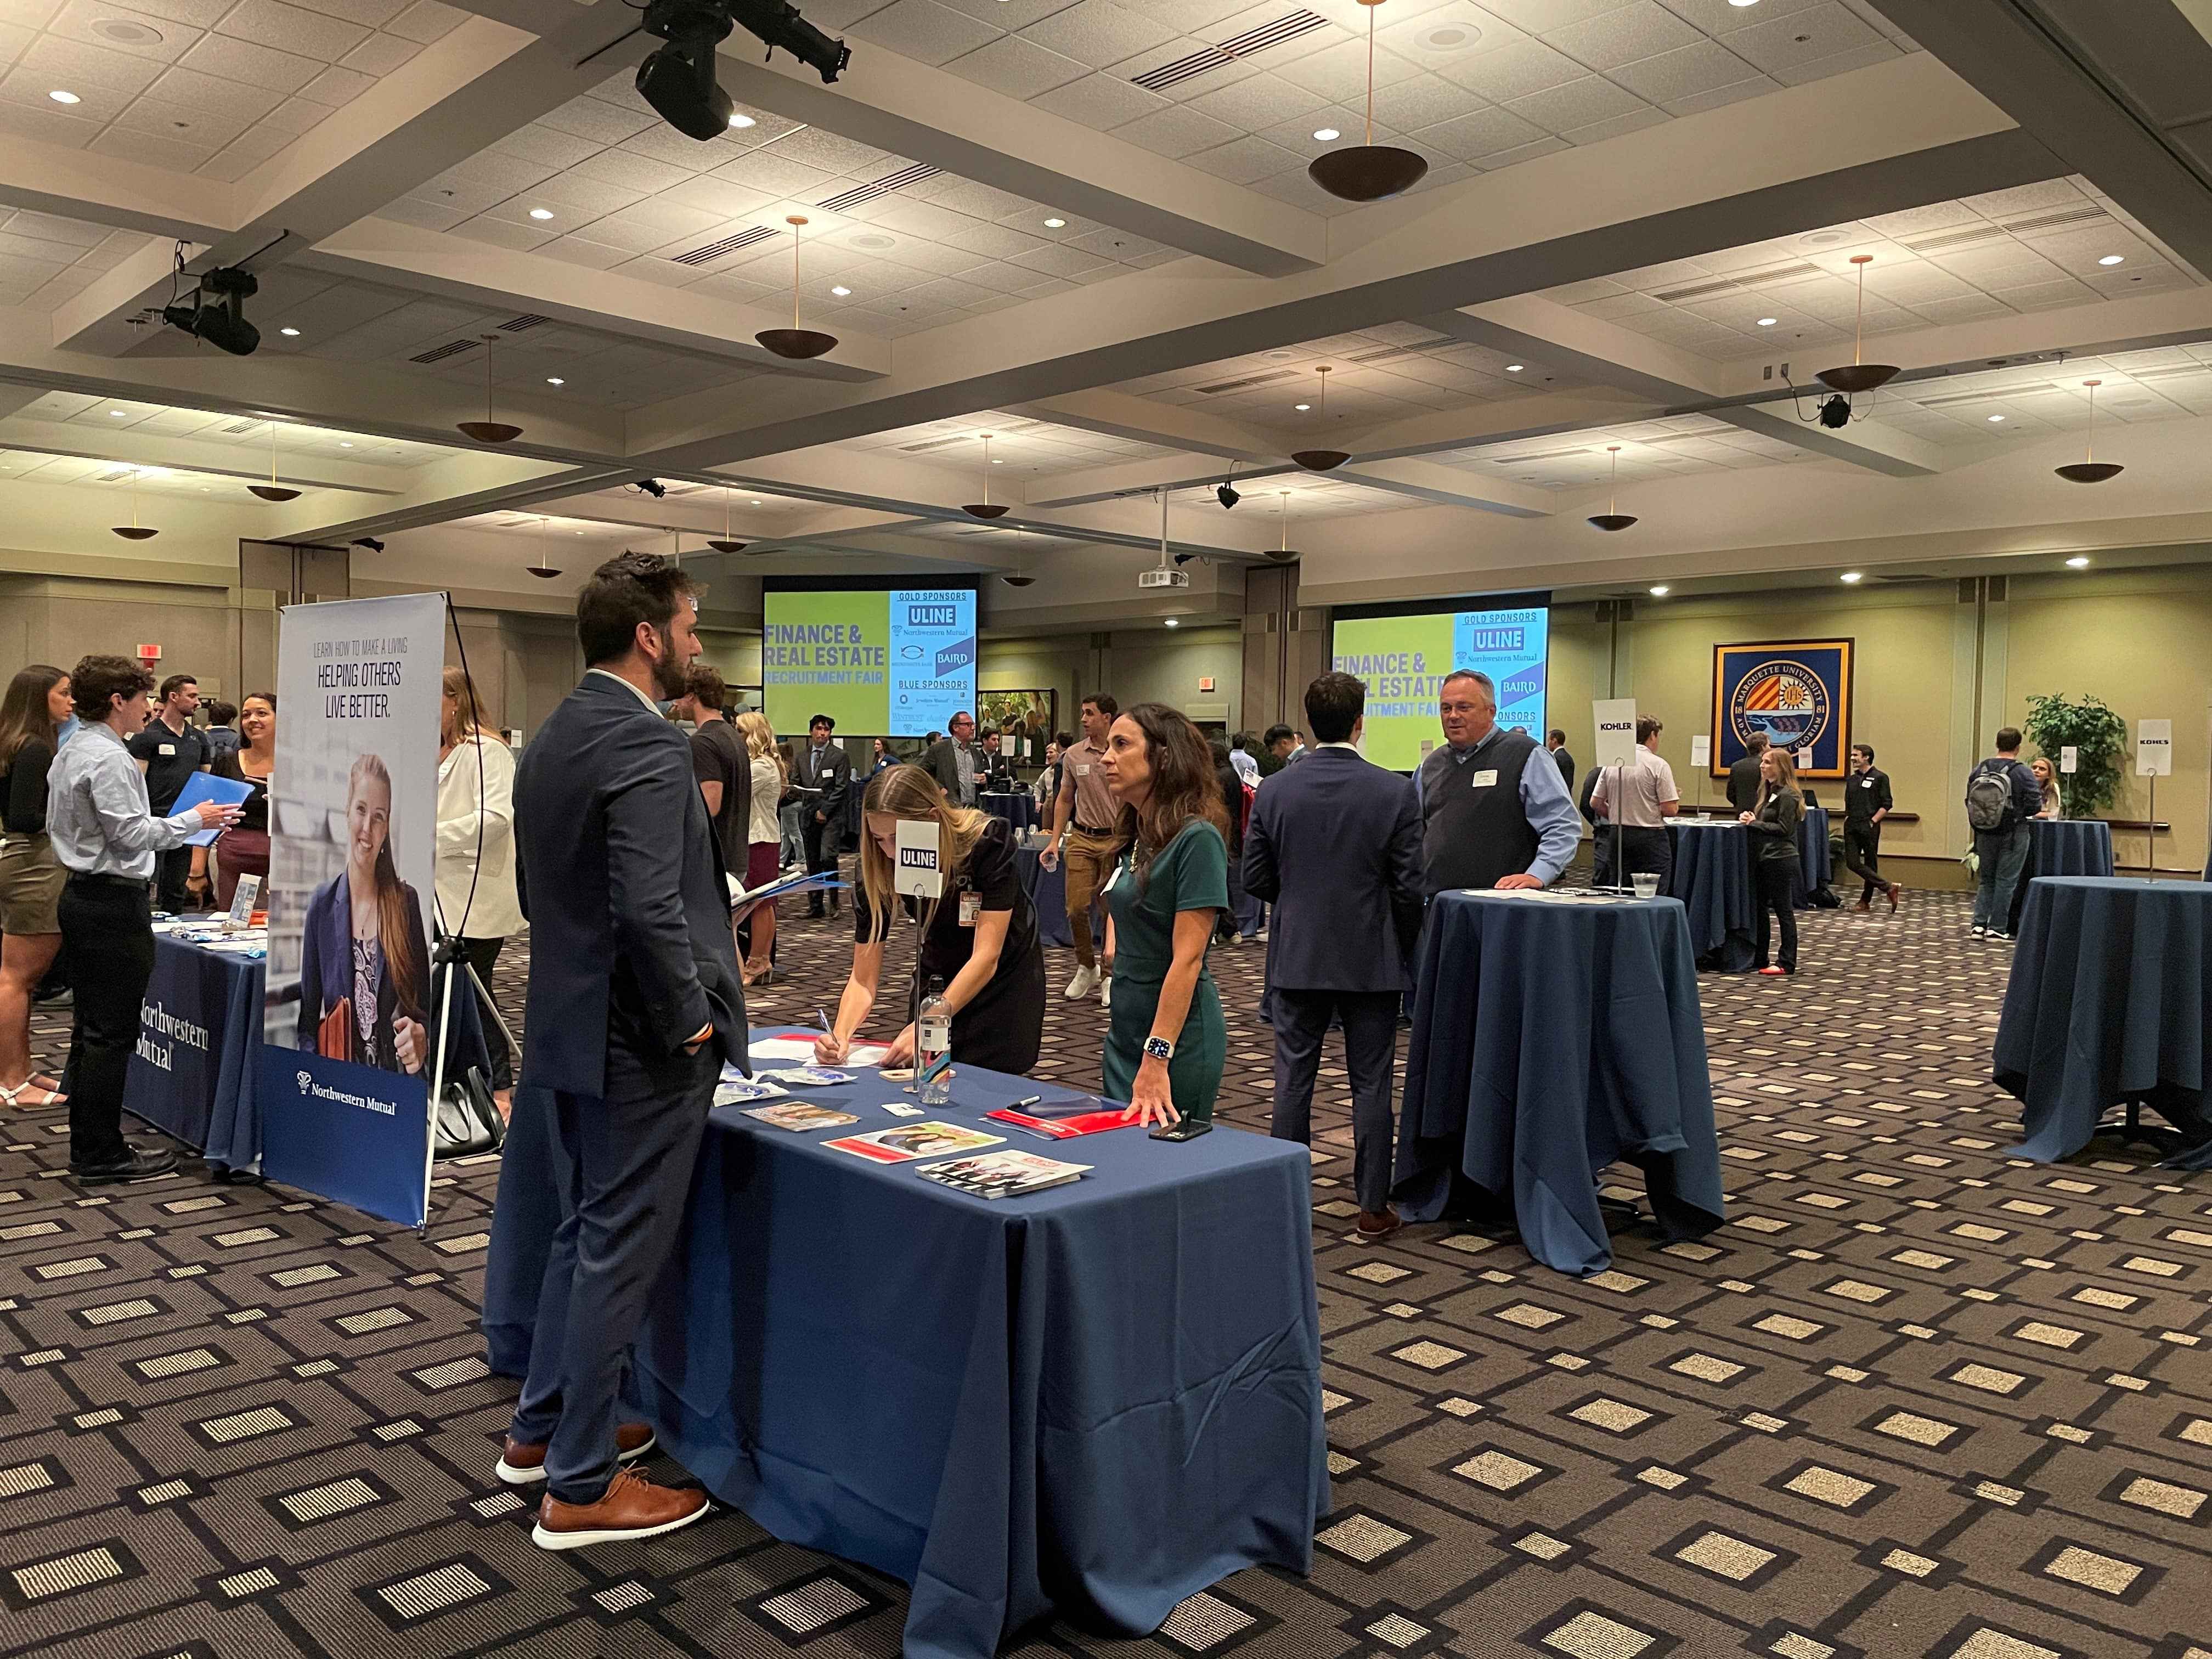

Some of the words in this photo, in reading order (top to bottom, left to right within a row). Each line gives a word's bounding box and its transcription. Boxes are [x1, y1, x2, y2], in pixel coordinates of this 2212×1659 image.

[899, 592, 920, 601] GOLD
[923, 592, 966, 600] SPONSORS
[911, 608, 953, 623] ULINE
[1464, 614, 1486, 624] GOLD
[1489, 612, 1537, 623] SPONSORS
[765, 624, 844, 644] FINANCE
[849, 624, 862, 644] &
[1476, 630, 1522, 649] ULINE
[314, 641, 333, 658] LEARN
[335, 641, 351, 657] HOW
[352, 640, 360, 656] TO
[362, 639, 379, 655] MAKE
[381, 639, 386, 654] A
[388, 637, 408, 654] LIVING
[765, 646, 810, 666] REAL
[815, 646, 885, 666] ESTATE
[937, 653, 967, 665] BAIRD
[1513, 653, 1537, 662] Mutual
[1333, 653, 1409, 675] FINANCE
[1413, 652, 1426, 673] &
[318, 663, 358, 688] HELPING
[362, 661, 401, 687] OTHERS
[765, 670, 852, 684] RECRUITMENT
[855, 670, 883, 684] FAIR
[899, 680, 919, 689] BLUE
[922, 680, 968, 689] SPONSORS
[1503, 681, 1536, 693] BAIRD
[1737, 665, 1780, 703] MARQUETTE
[1782, 665, 1822, 701] UNIVERSITY
[326, 695, 346, 718] LIVE
[349, 694, 390, 718] BETTER.
[1364, 702, 1415, 716] ITMENT
[1418, 702, 1440, 716] FAI
[1735, 706, 1743, 714] 18
[1816, 705, 1825, 713] 81
[1498, 712, 1536, 721] ONSORS
[1737, 718, 1744, 728] AD
[1600, 722, 1632, 731] KOHLER
[1795, 717, 1822, 748] GLORIAM
[902, 850, 935, 867] ULINE
[311, 1083, 365, 1108] Northwestern
[367, 1096, 395, 1115] Mutual
